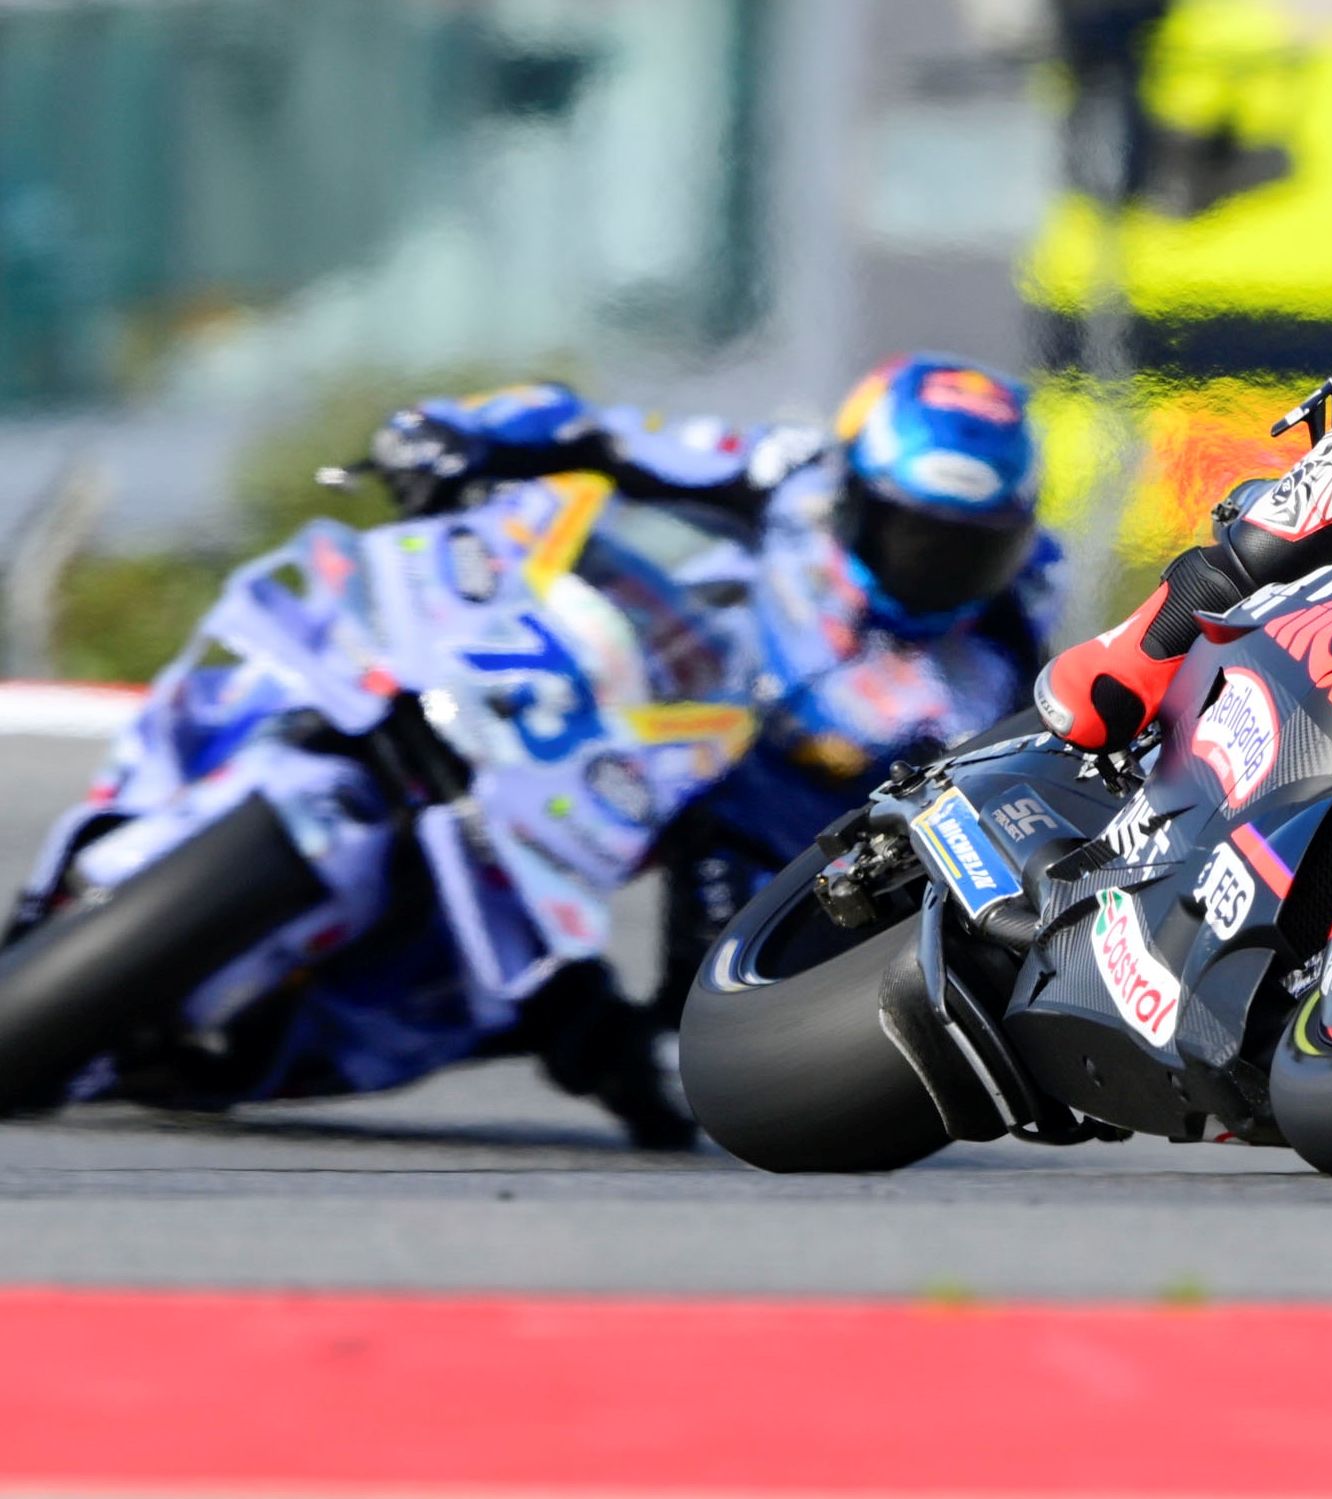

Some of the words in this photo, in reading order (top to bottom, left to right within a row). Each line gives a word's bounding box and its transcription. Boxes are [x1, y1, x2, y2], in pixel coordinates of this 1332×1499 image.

[461, 613, 602, 762] 73
[938, 818, 997, 889] MICHELIN
[1002, 799, 1057, 836] SC
[1102, 915, 1178, 1033] Castrol
